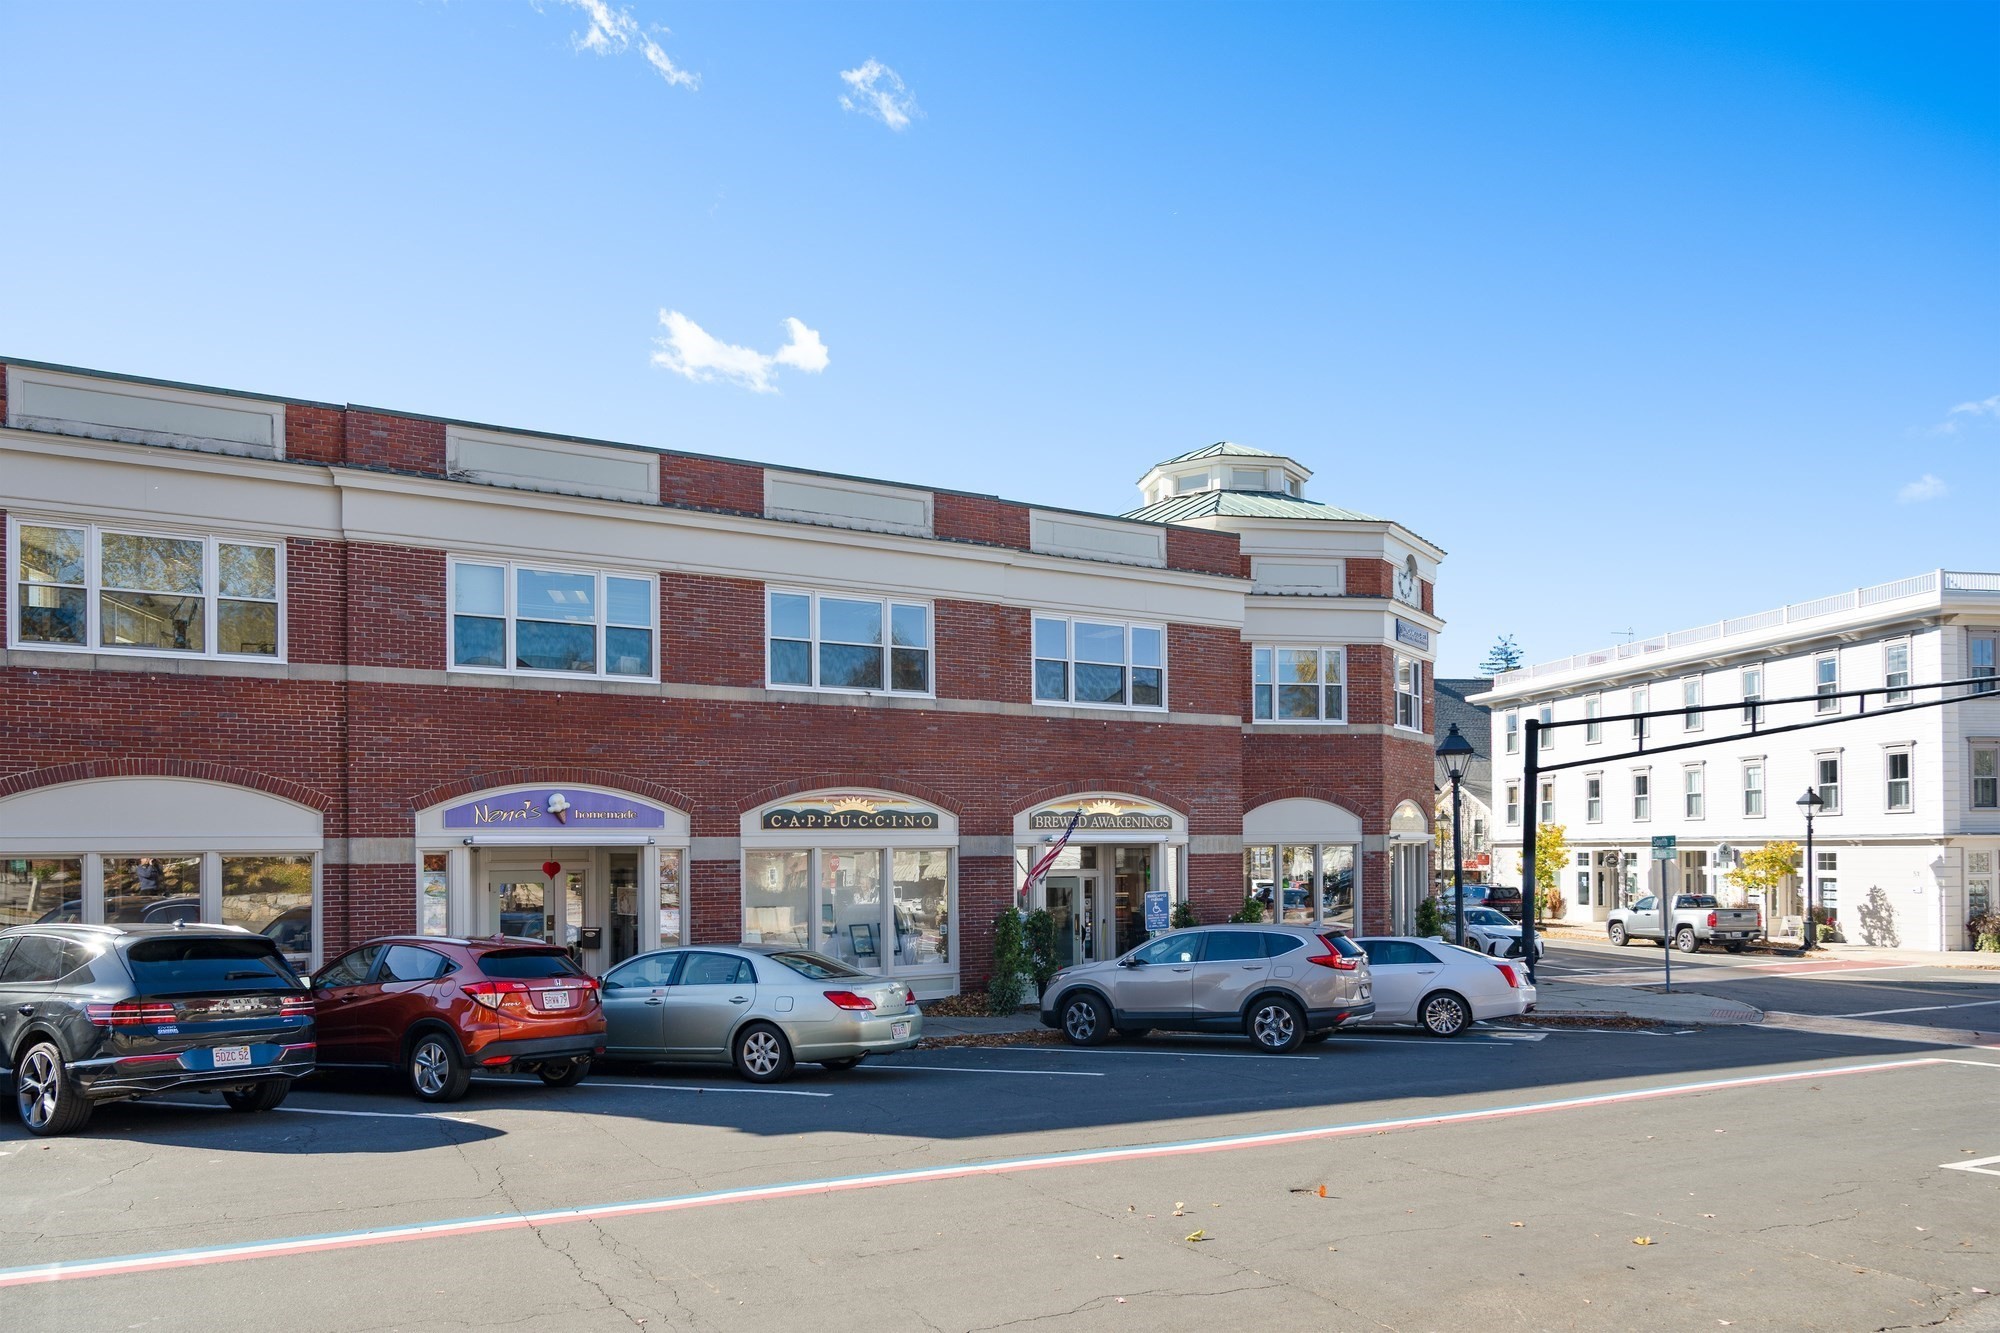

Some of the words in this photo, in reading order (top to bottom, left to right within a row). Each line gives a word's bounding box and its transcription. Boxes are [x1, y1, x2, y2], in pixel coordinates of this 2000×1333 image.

[474, 800, 542, 825] Nona's
[574, 809, 638, 820] homemade
[1034, 815, 1087, 828] BREWD
[1091, 815, 1169, 828] AWAKENINGS
[215, 1052, 236, 1062] 5DZC
[238, 1051, 249, 1060] 52
